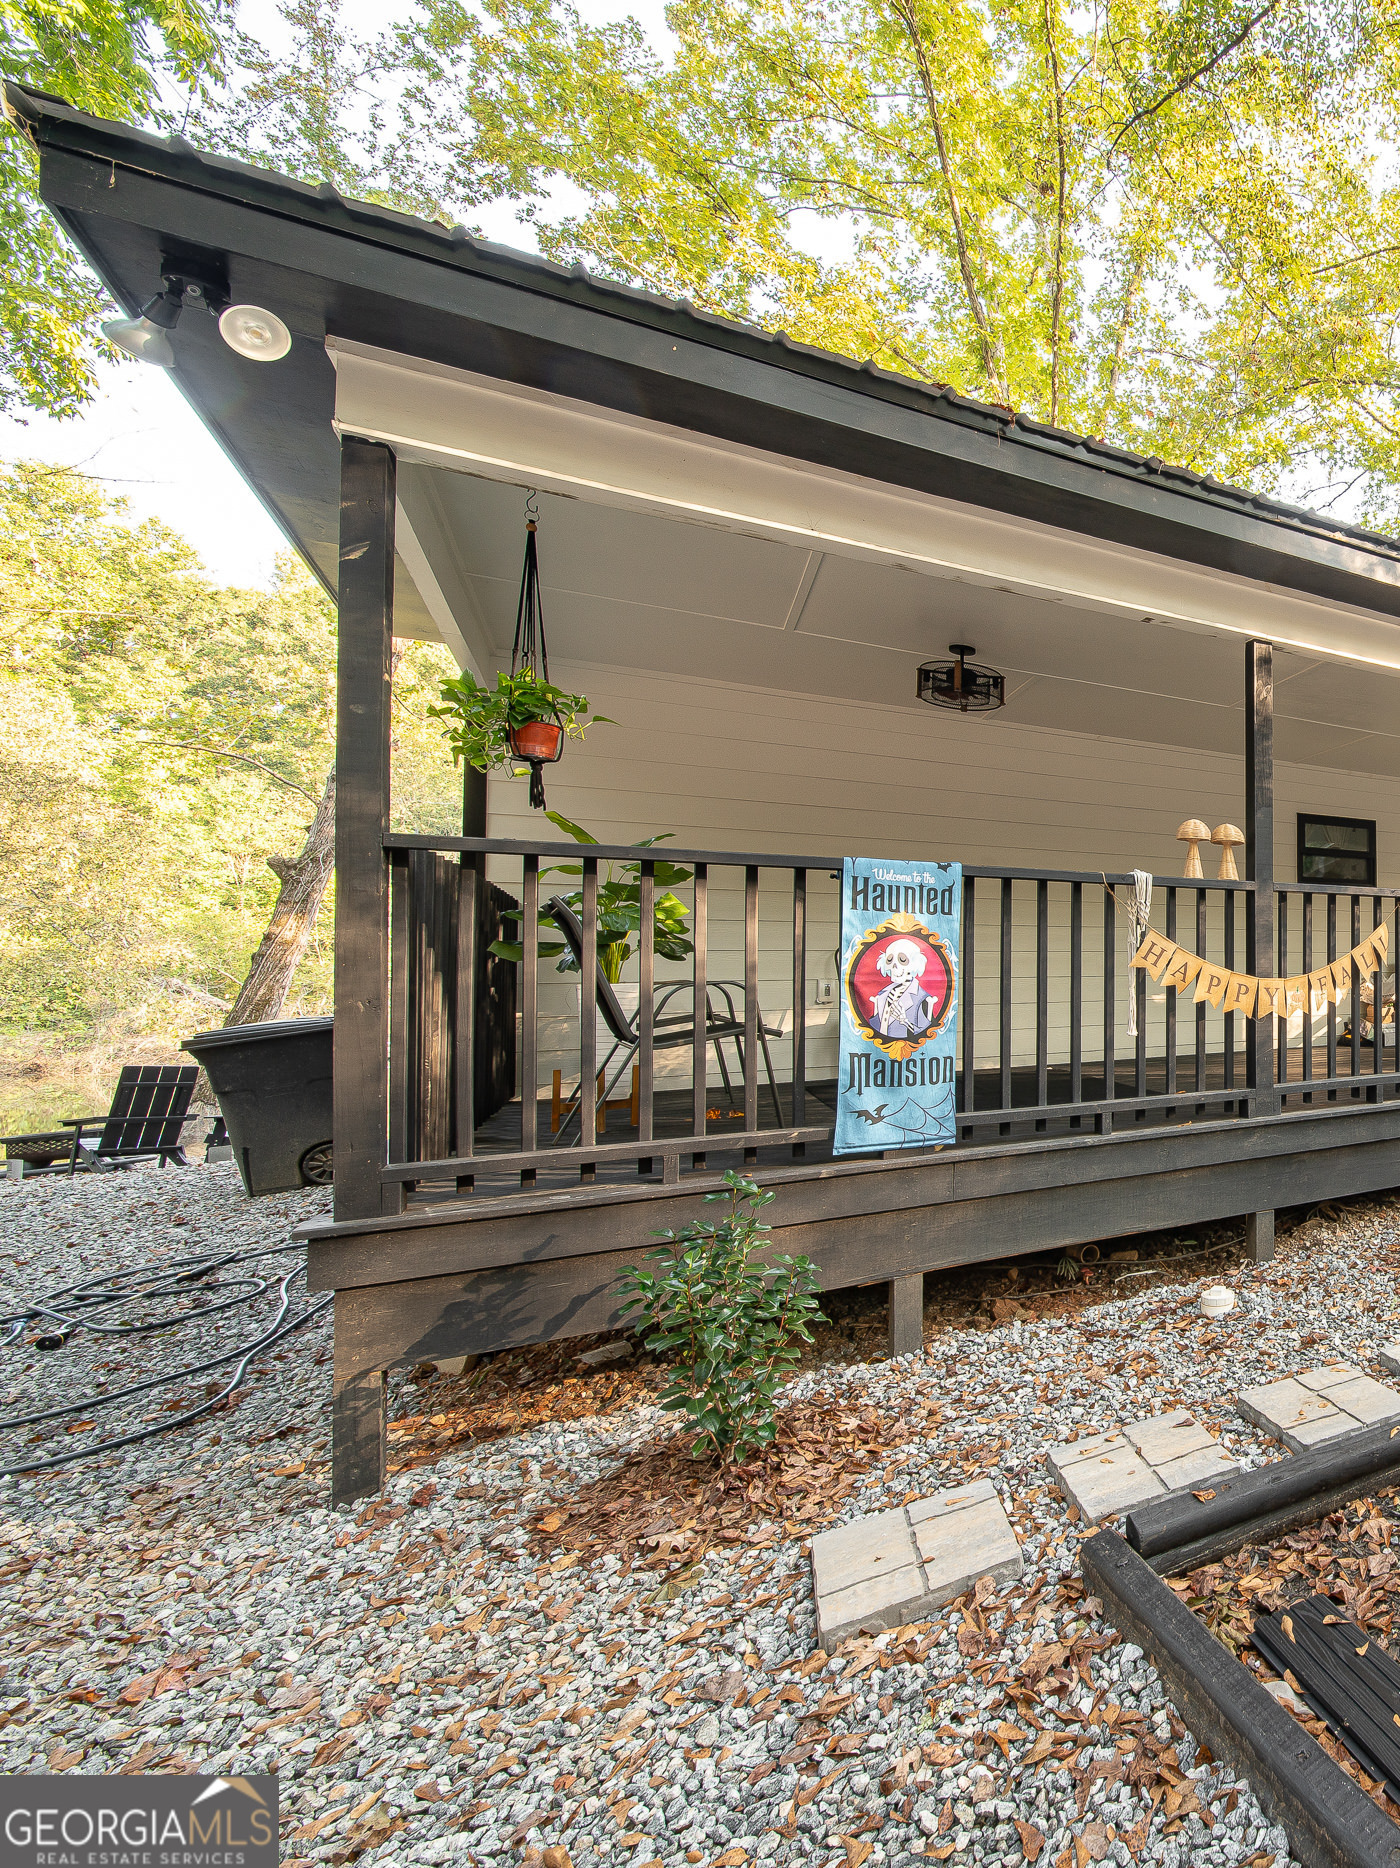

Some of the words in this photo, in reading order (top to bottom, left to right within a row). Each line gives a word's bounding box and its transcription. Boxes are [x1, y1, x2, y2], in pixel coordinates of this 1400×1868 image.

[850, 875, 956, 916] Haunted
[872, 868, 912, 883] Welcome
[913, 871, 921, 883] to
[922, 871, 936, 884] the
[1140, 940, 1281, 1007] HAPPY
[1316, 936, 1388, 996] FALL
[841, 1051, 954, 1097] Mansion
